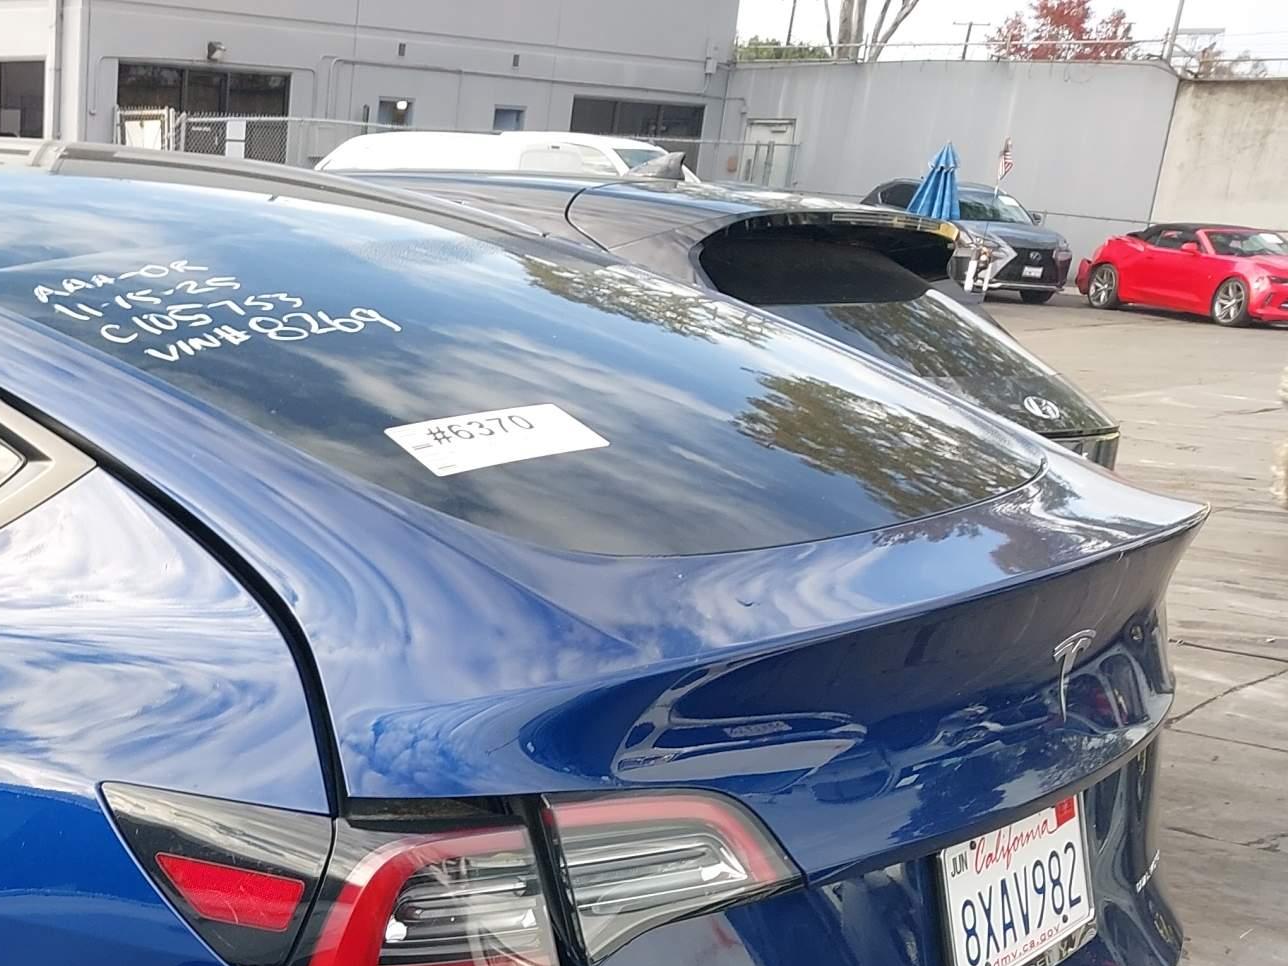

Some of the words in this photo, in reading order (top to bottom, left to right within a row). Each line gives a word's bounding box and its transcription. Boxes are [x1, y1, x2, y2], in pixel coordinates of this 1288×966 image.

[53, 277, 242, 321] 11-15-25
[426, 414, 535, 445] #6370
[950, 850, 969, 878] JUN
[974, 818, 1058, 875] California
[961, 841, 1082, 966] 8XAV982
